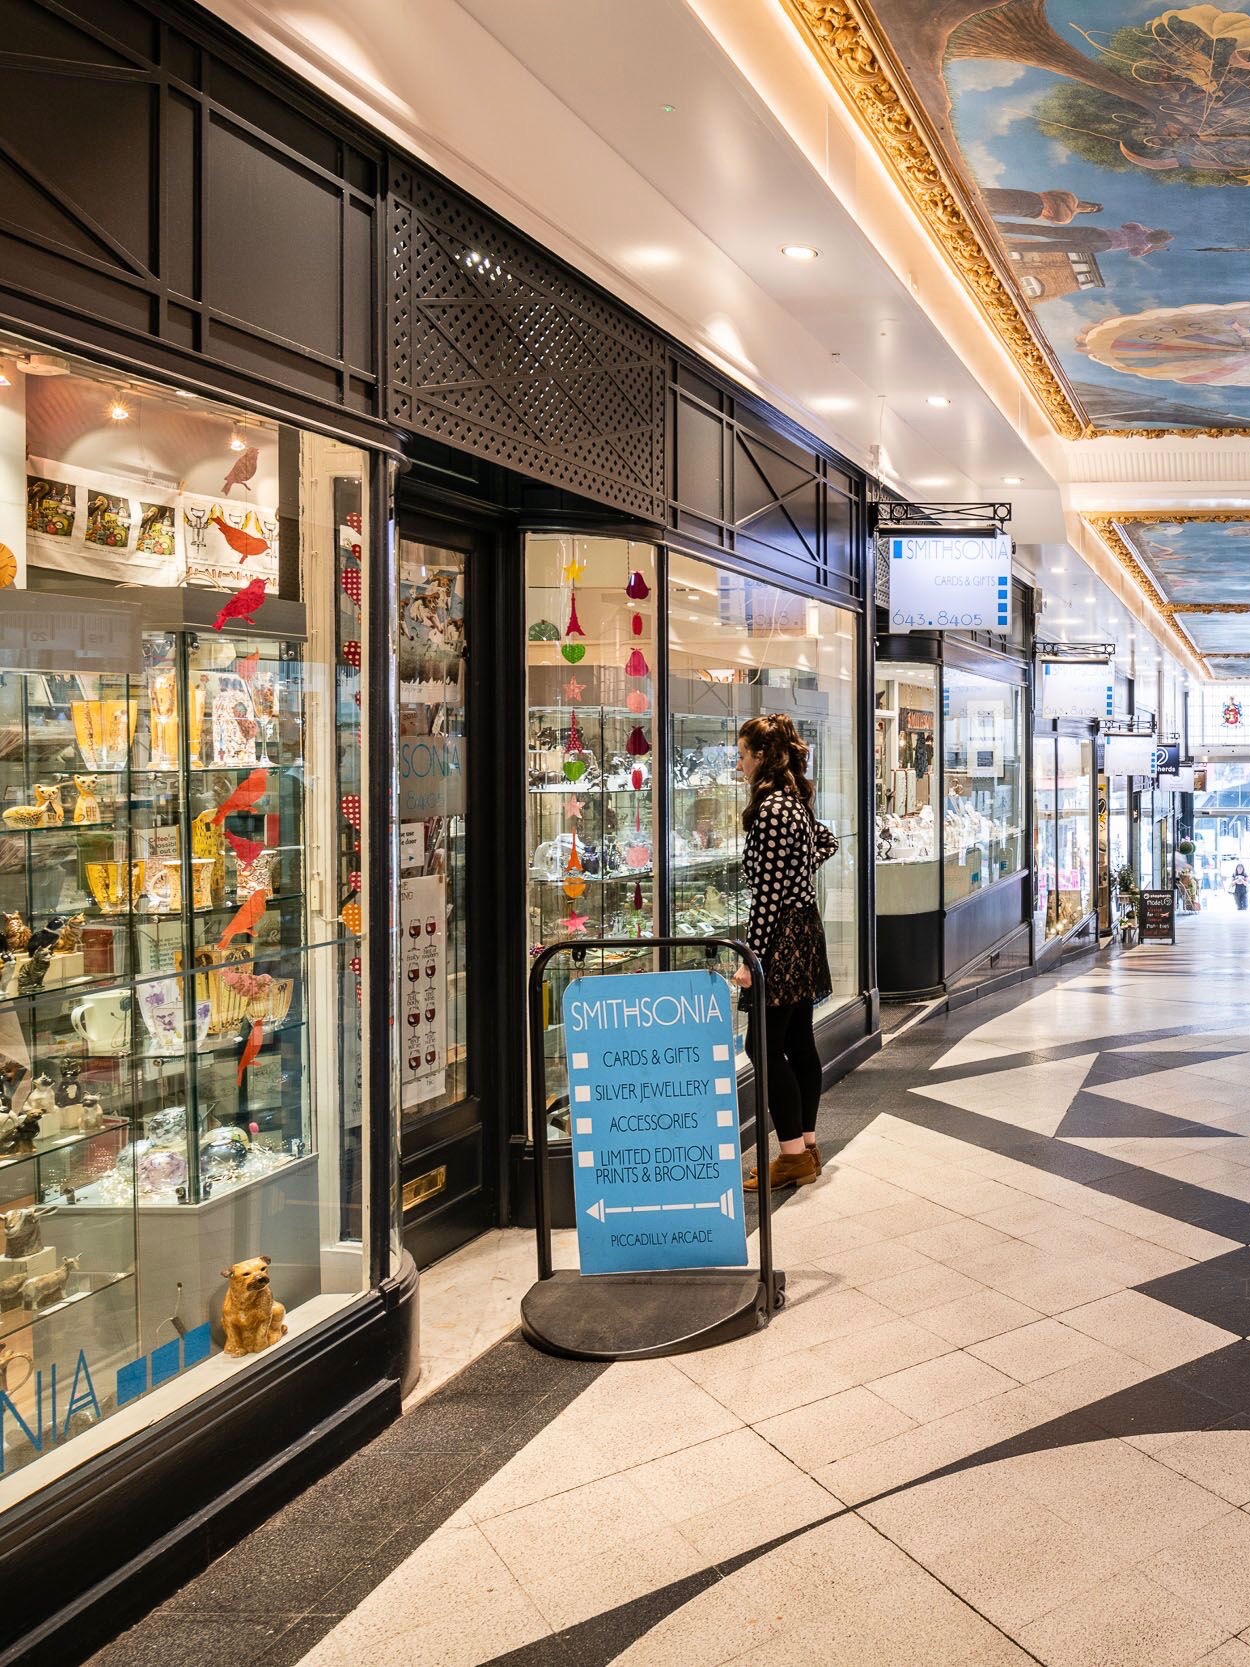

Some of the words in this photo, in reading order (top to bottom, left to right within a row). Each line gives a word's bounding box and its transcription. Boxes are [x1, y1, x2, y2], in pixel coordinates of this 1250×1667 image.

[906, 540, 1008, 560] SMITHSONIA
[935, 575, 963, 586] CARDS
[964, 575, 971, 586] &
[973, 575, 996, 587] GIFTS
[892, 609, 983, 627] 643.8405
[572, 994, 723, 1031] SMITHSONIA
[603, 1049, 648, 1067] CARDS
[651, 1048, 661, 1064] &
[664, 1047, 700, 1064] GIFTS
[595, 1083, 638, 1101] SILVER
[640, 1079, 709, 1103] JEWELLERY
[610, 1113, 698, 1132] ACCESSORIES
[600, 1148, 651, 1167] LIMITED
[655, 1145, 713, 1164] EDITION
[596, 1167, 639, 1185] PRINTS
[642, 1167, 651, 1182] &
[655, 1163, 720, 1181] BRONZES
[611, 1232, 669, 1247] PICCADILLY
[670, 1230, 713, 1243] ARCADE
